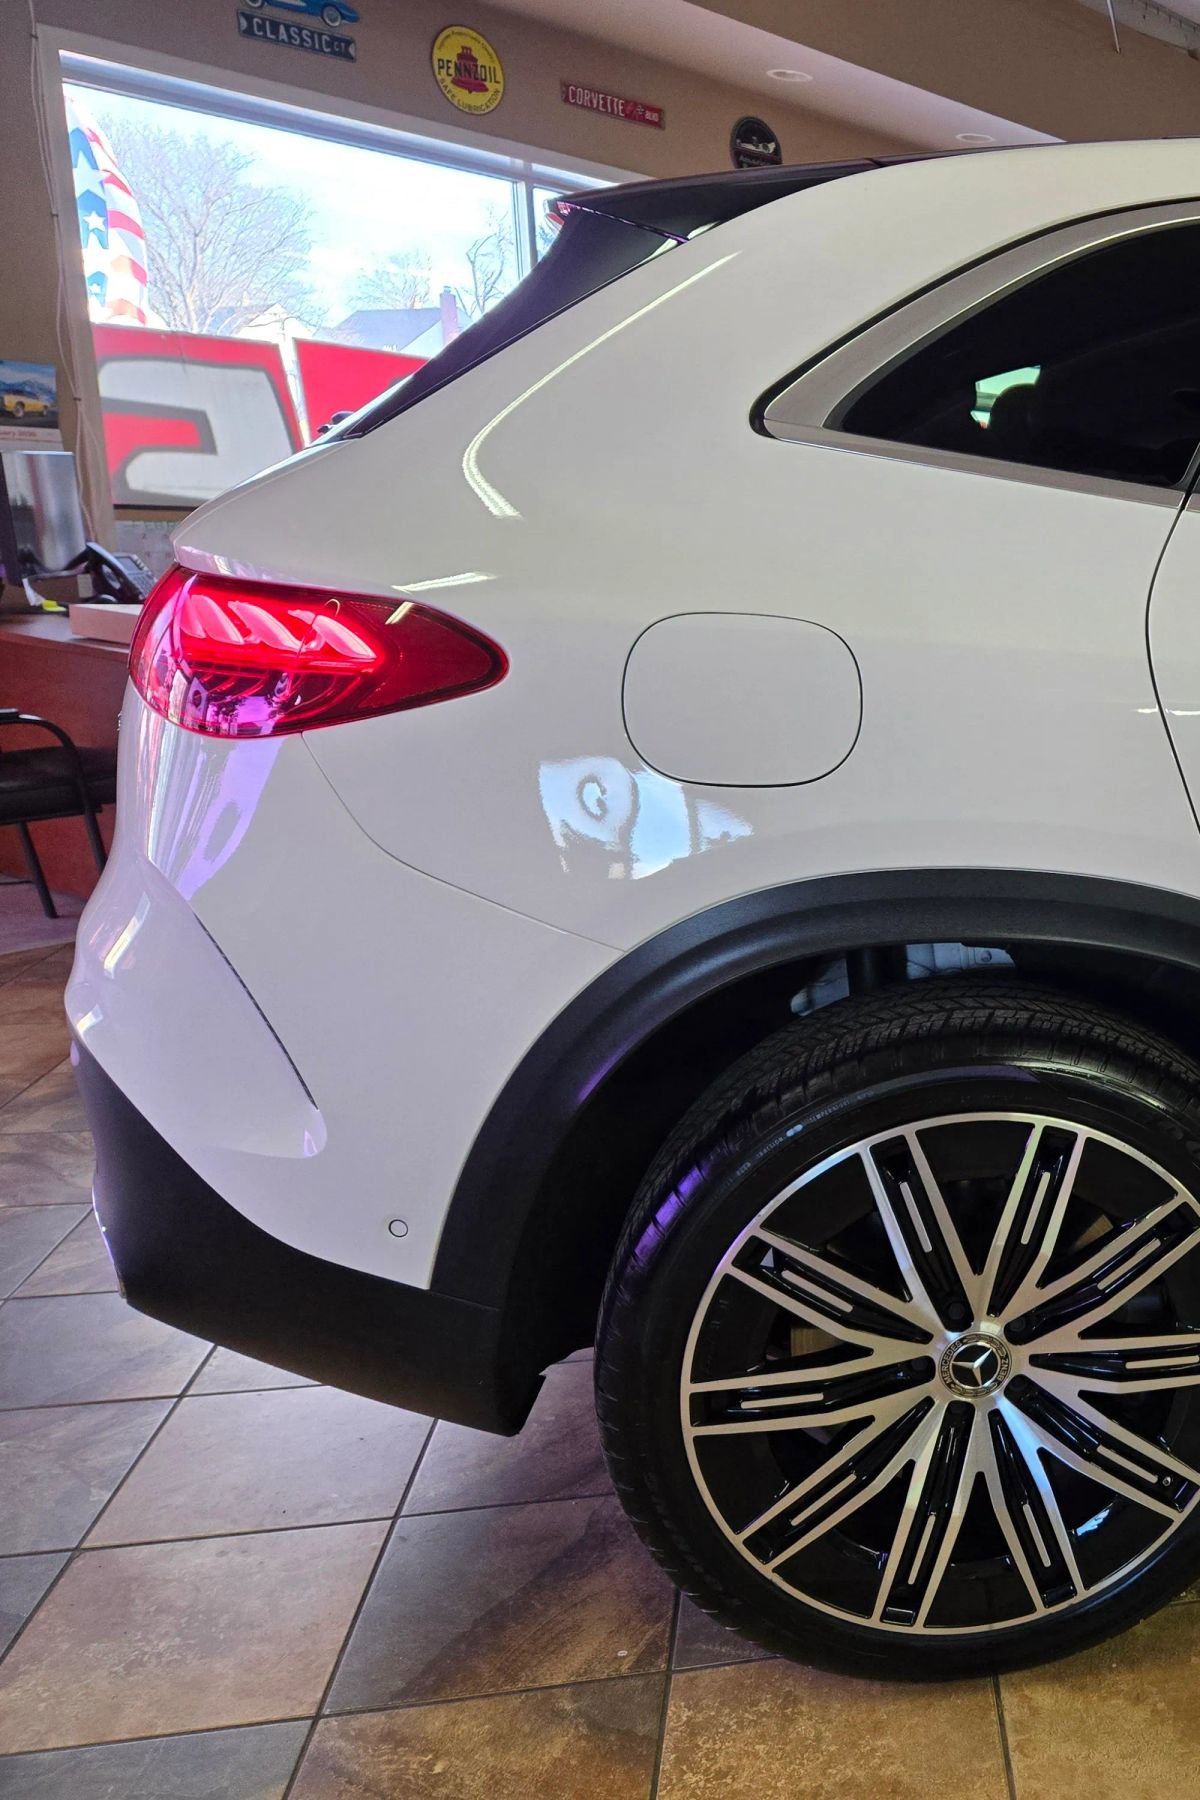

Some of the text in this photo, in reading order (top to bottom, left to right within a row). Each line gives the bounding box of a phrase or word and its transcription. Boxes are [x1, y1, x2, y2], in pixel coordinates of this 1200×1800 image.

[253, 18, 331, 52] CLASSIC
[437, 58, 501, 84] PENNZOIL
[568, 86, 625, 117] CORVETTE
[941, 1341, 963, 1385] MERCEDES
[997, 1357, 1009, 1382] BENZ
